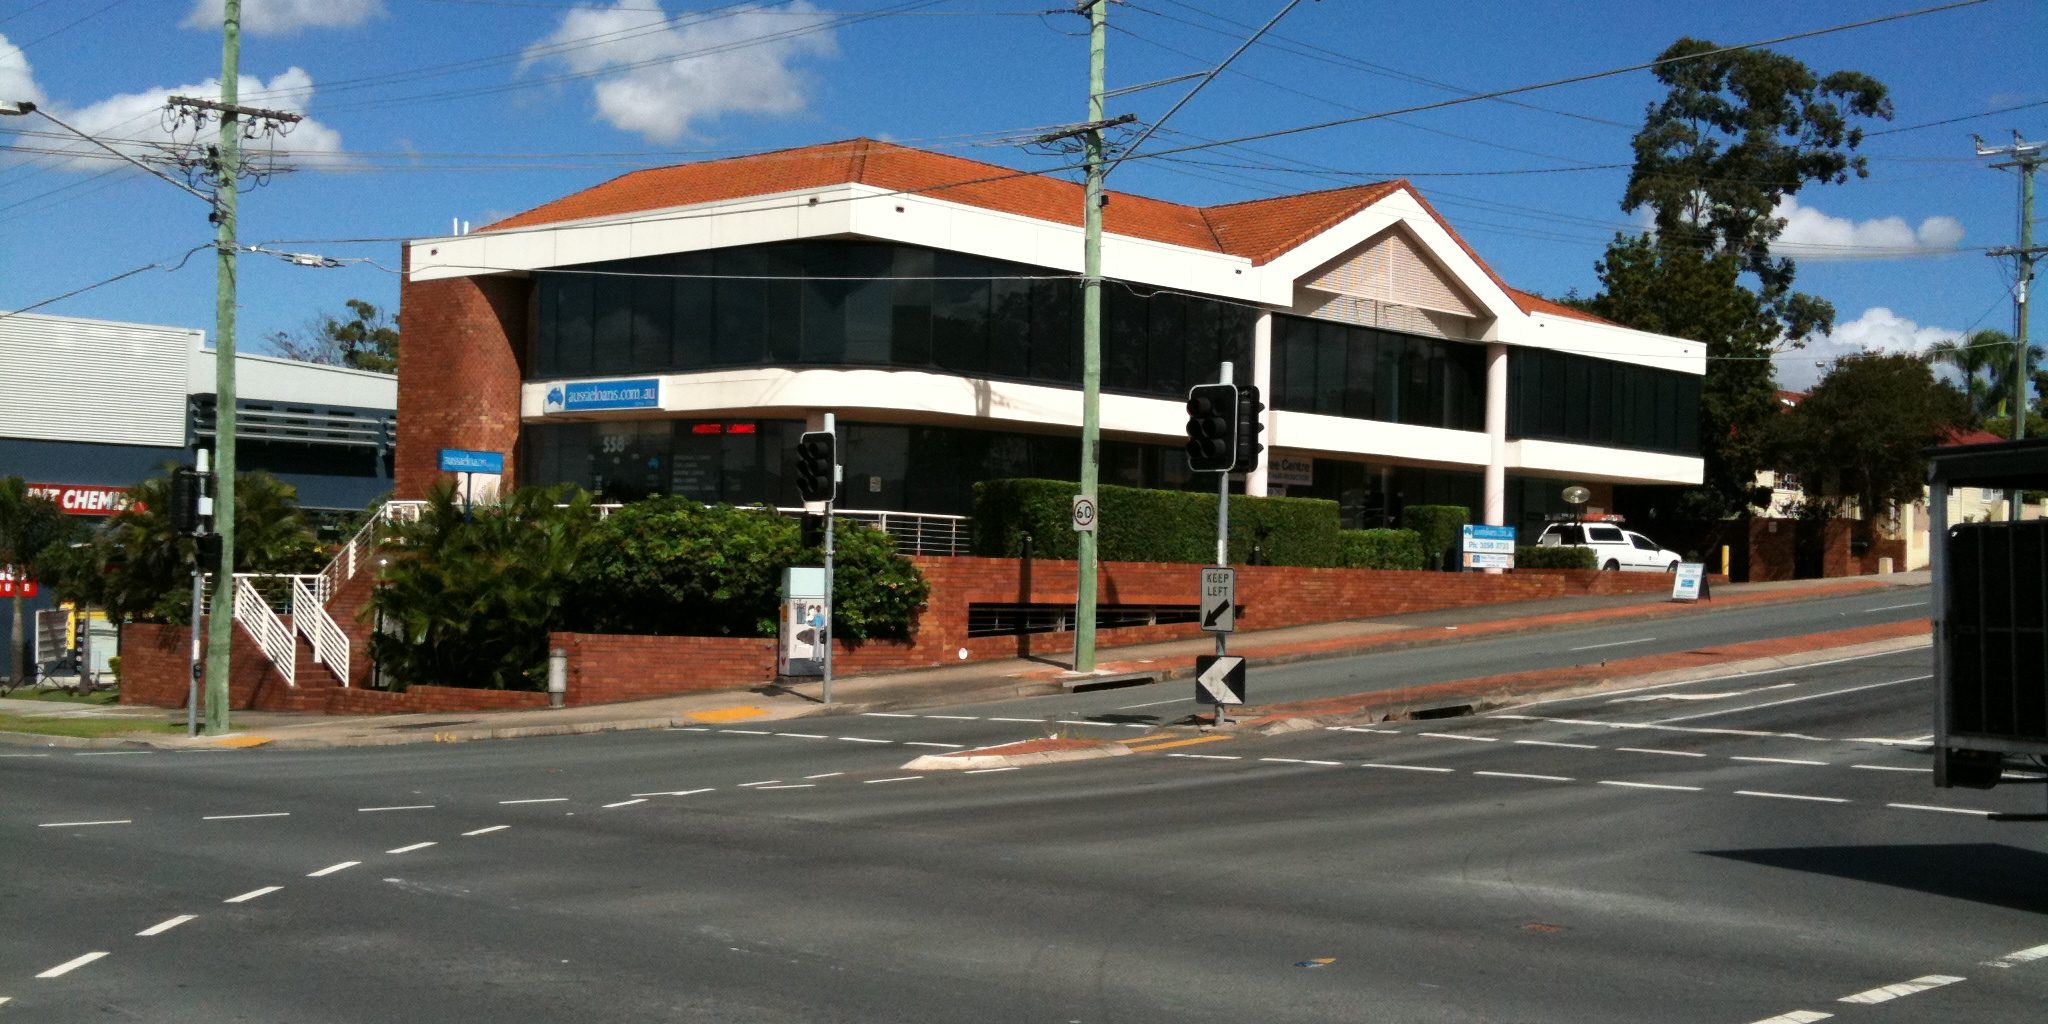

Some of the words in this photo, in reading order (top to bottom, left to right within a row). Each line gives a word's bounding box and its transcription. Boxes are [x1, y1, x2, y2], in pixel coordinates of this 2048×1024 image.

[1076, 505, 1092, 519] 60
[1206, 573, 1229, 583] KEEP
[1207, 586, 1228, 597] LEFT
